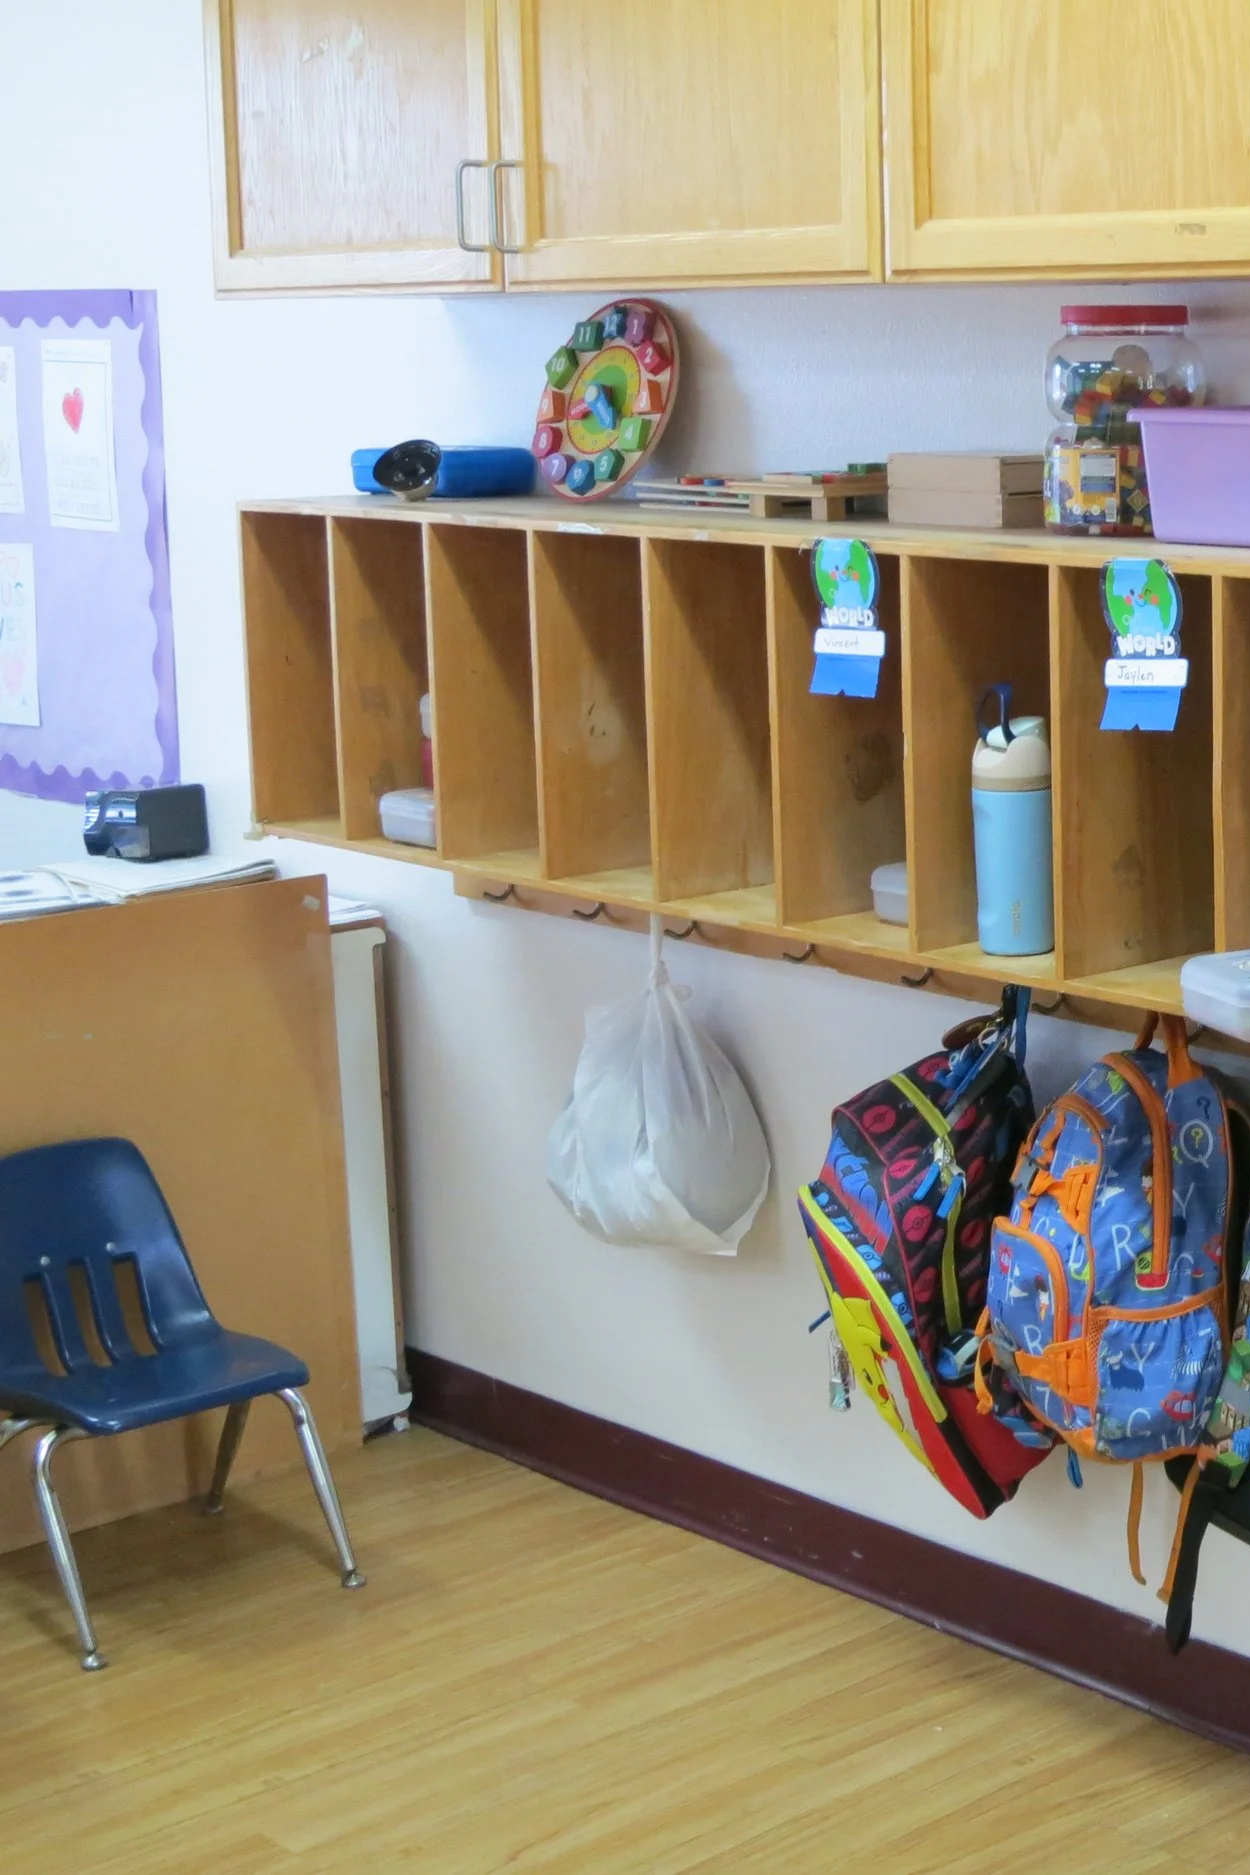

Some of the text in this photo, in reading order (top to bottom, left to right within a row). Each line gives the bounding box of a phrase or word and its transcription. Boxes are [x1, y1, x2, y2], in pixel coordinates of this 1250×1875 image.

[578, 326, 591, 343] 11
[644, 347, 654, 364] 2
[551, 357, 565, 373] 10
[623, 423, 634, 441] 4
[539, 434, 548, 449] 8
[551, 459, 561, 477] 7
[600, 455, 609, 472] 5
[573, 465, 582, 482] 6
[824, 606, 874, 628] WORLD
[823, 636, 860, 649] Vincent
[1116, 632, 1176, 657] WORLD
[1117, 665, 1154, 684] Jaylen
